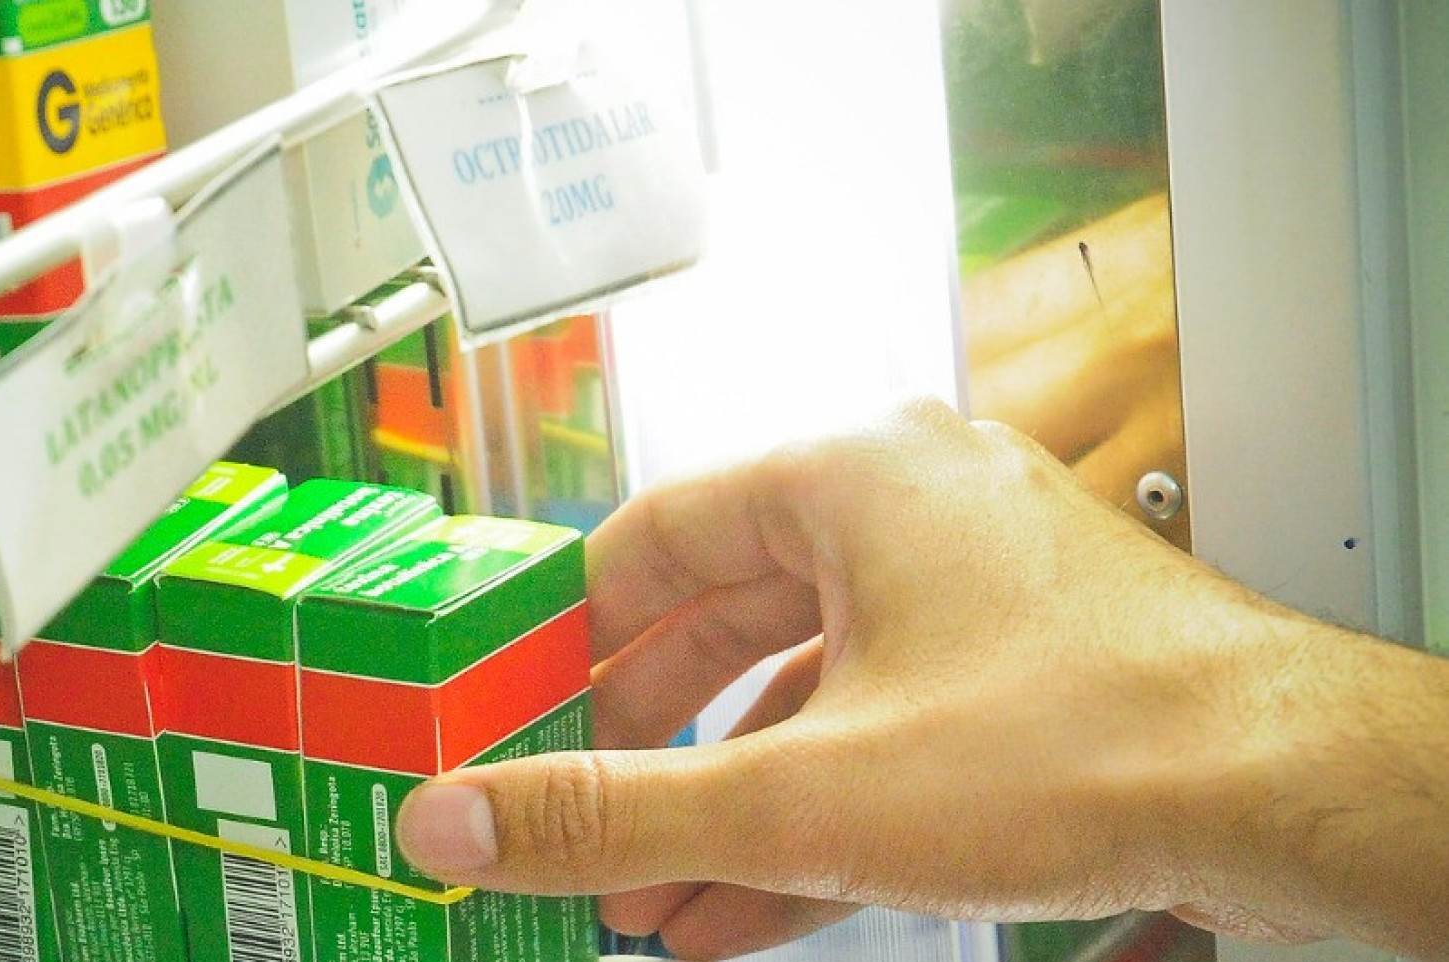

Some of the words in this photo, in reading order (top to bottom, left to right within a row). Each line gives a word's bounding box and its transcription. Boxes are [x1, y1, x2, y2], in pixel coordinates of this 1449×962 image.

[37, 71, 81, 154] G
[453, 111, 613, 185] OCTROTIDA
[542, 173, 615, 227] 20MG
[277, 864, 294, 919] 17101
